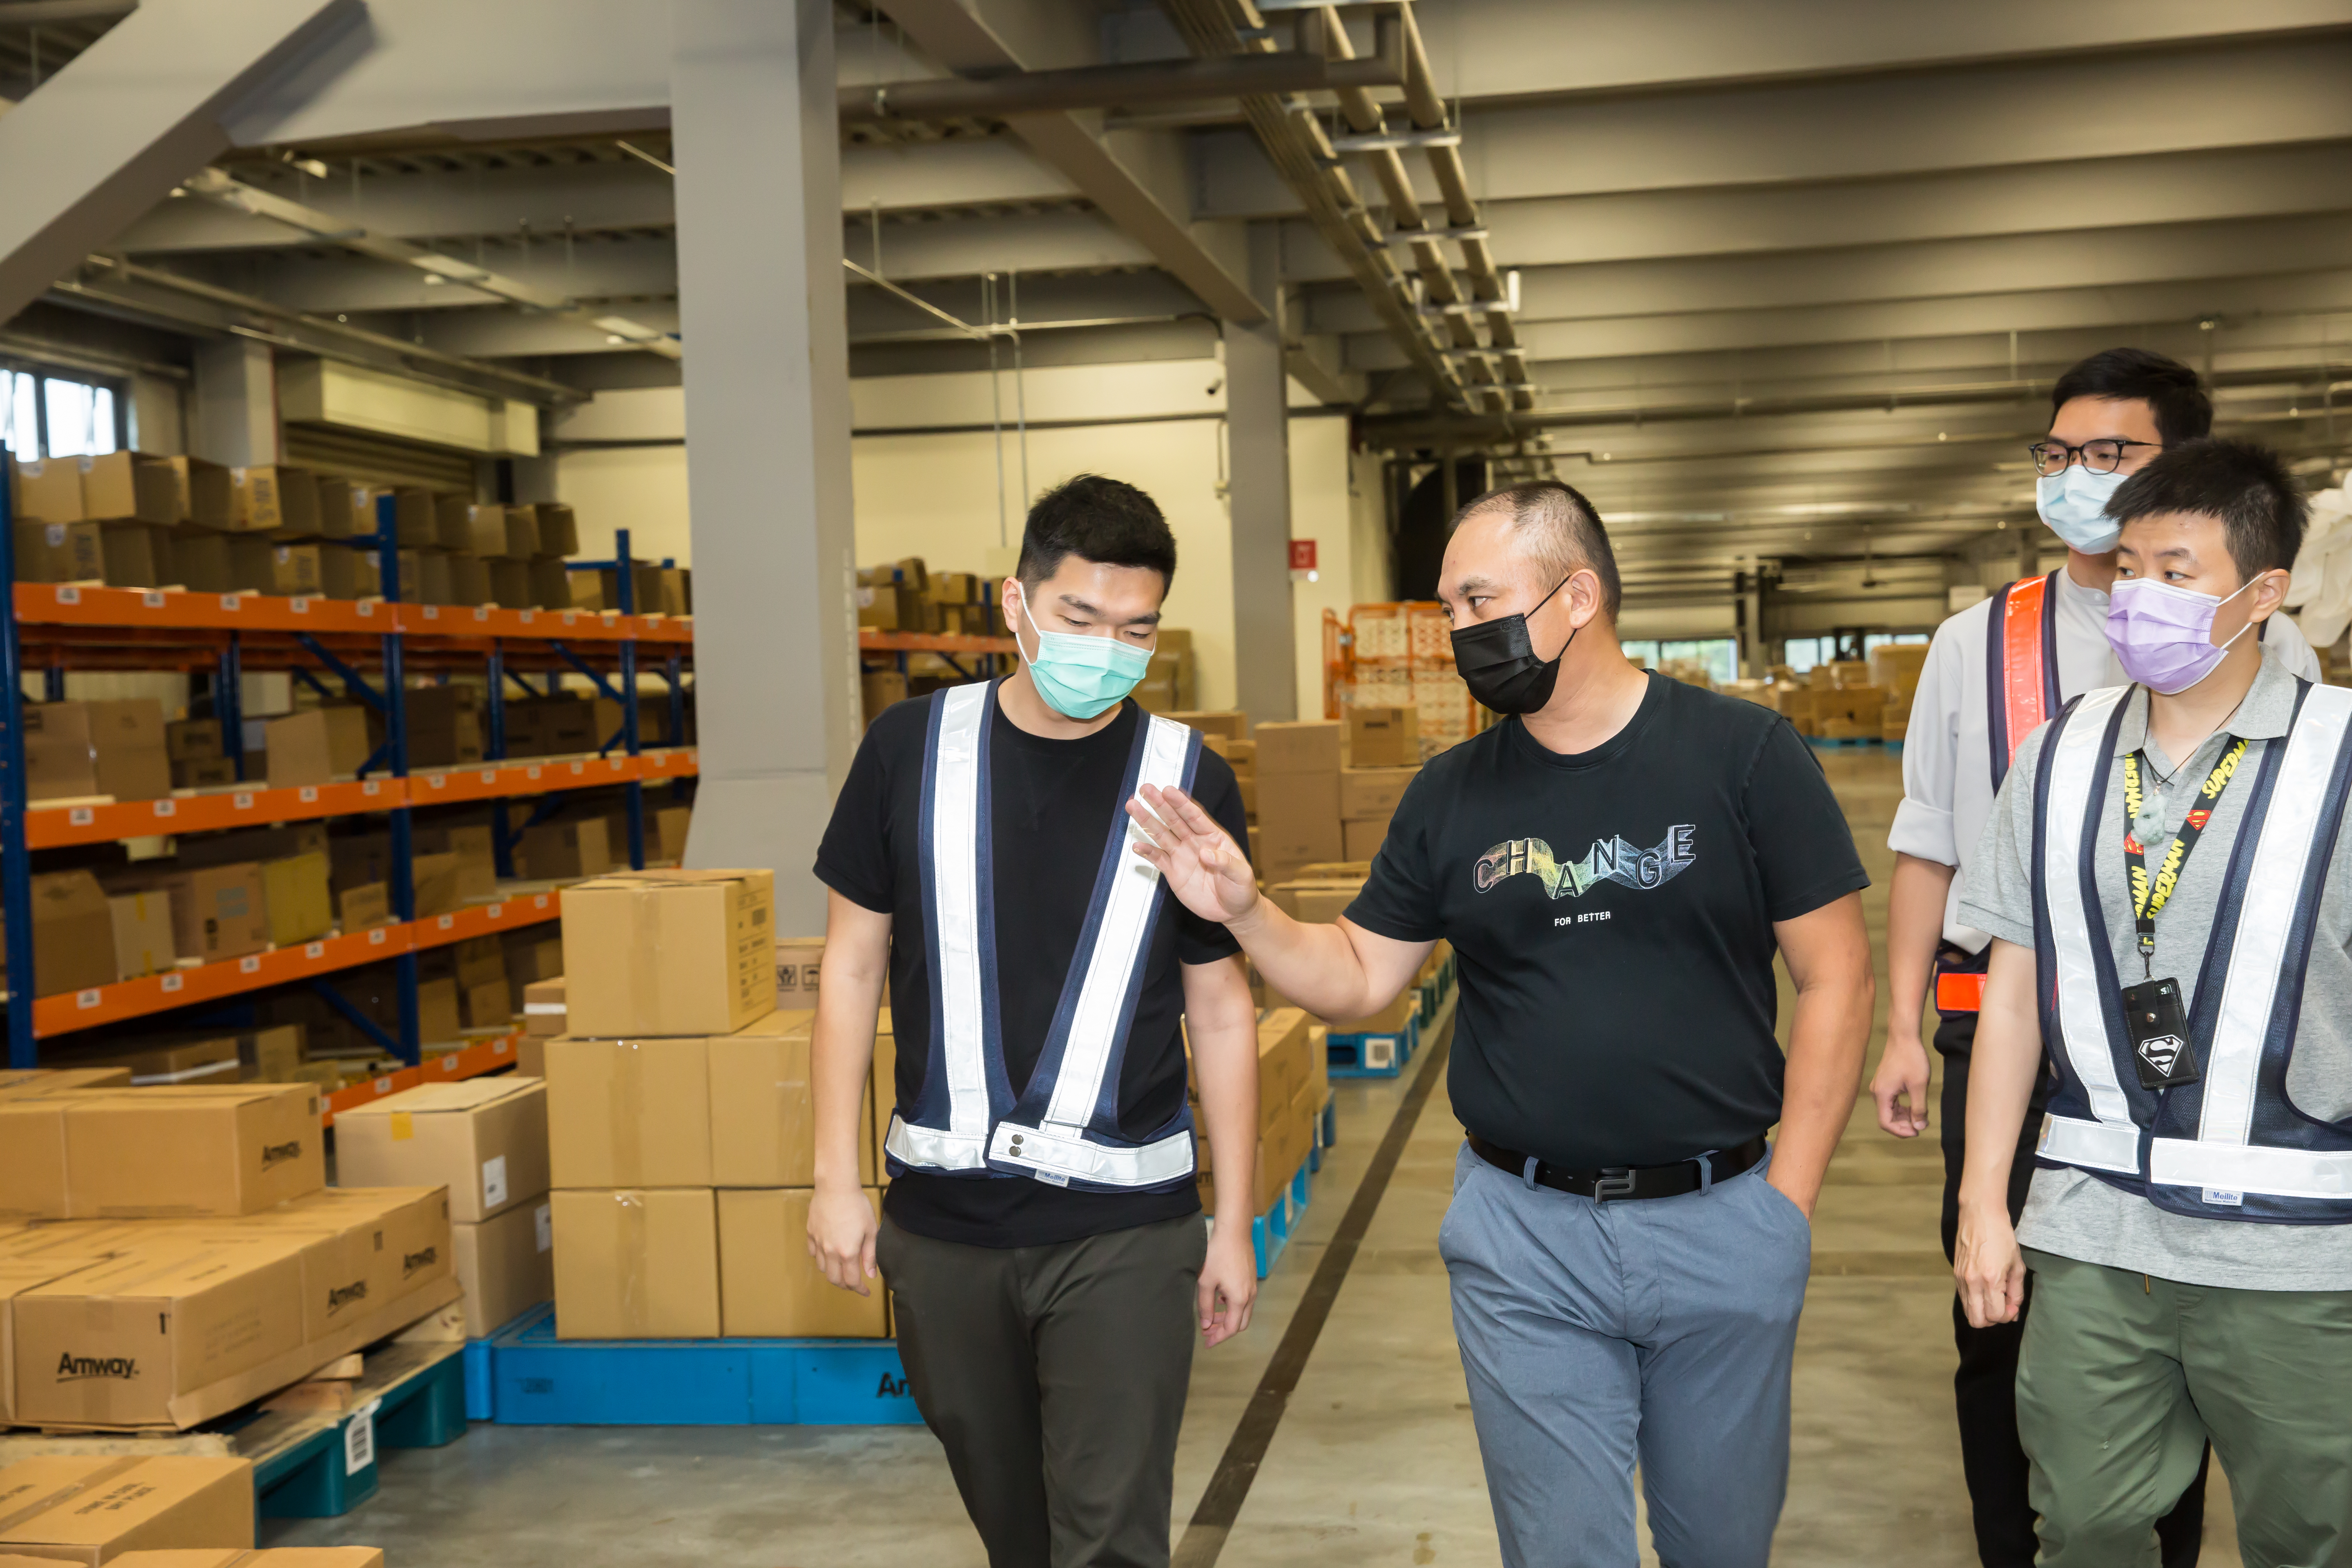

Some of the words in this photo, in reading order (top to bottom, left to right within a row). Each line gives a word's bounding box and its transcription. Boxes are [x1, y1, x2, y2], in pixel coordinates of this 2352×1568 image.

[2202, 739, 2250, 799] SUPERM
[1473, 824, 1696, 900] CHANGE
[1554, 917, 1571, 927] FOR
[1577, 911, 1611, 923] BETTER
[1044, 1172, 1065, 1182] Meilite
[2213, 1192, 2238, 1200] Meilite
[57, 1352, 136, 1379] Amway
